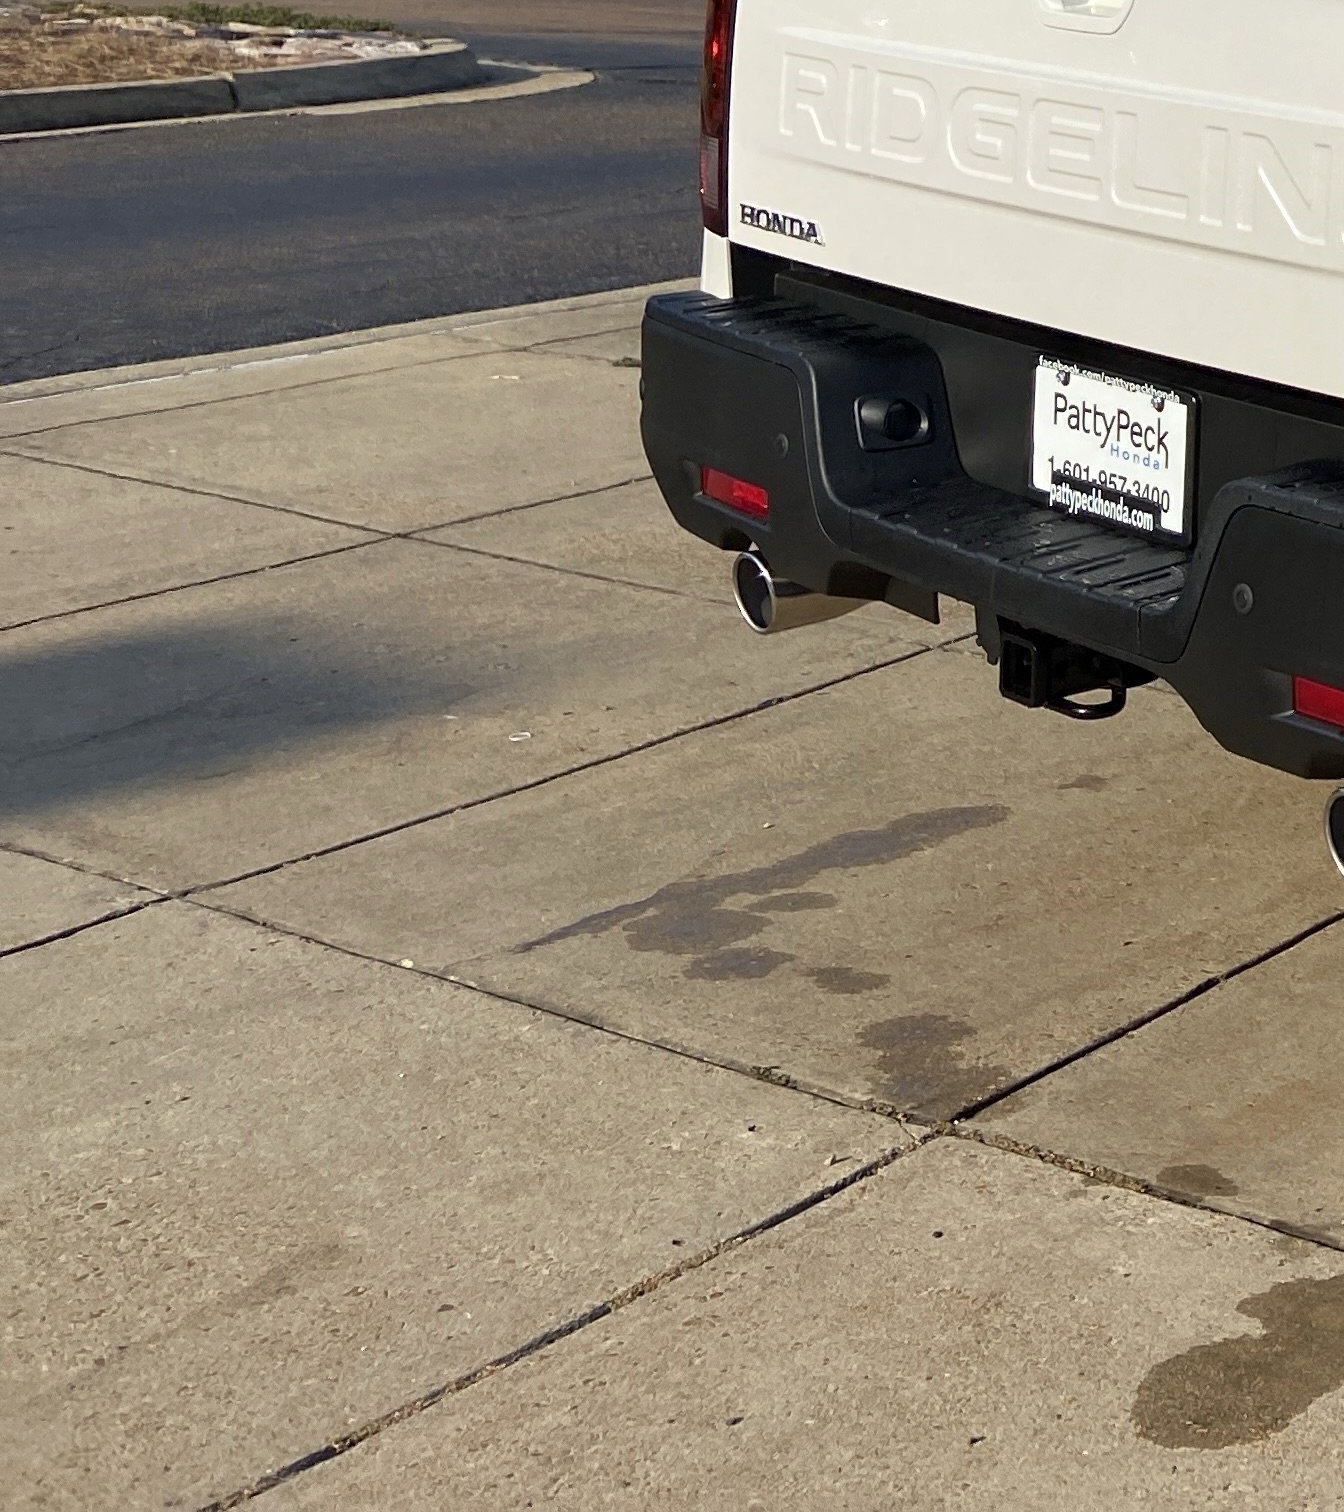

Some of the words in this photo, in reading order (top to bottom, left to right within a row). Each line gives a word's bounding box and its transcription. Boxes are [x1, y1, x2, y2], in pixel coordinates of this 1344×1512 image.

[740, 203, 825, 247] HONDA
[1054, 392, 1168, 469] PattyPeck
[1110, 443, 1160, 470] Honda
[1049, 481, 1154, 531] pattypeckhonda.com
